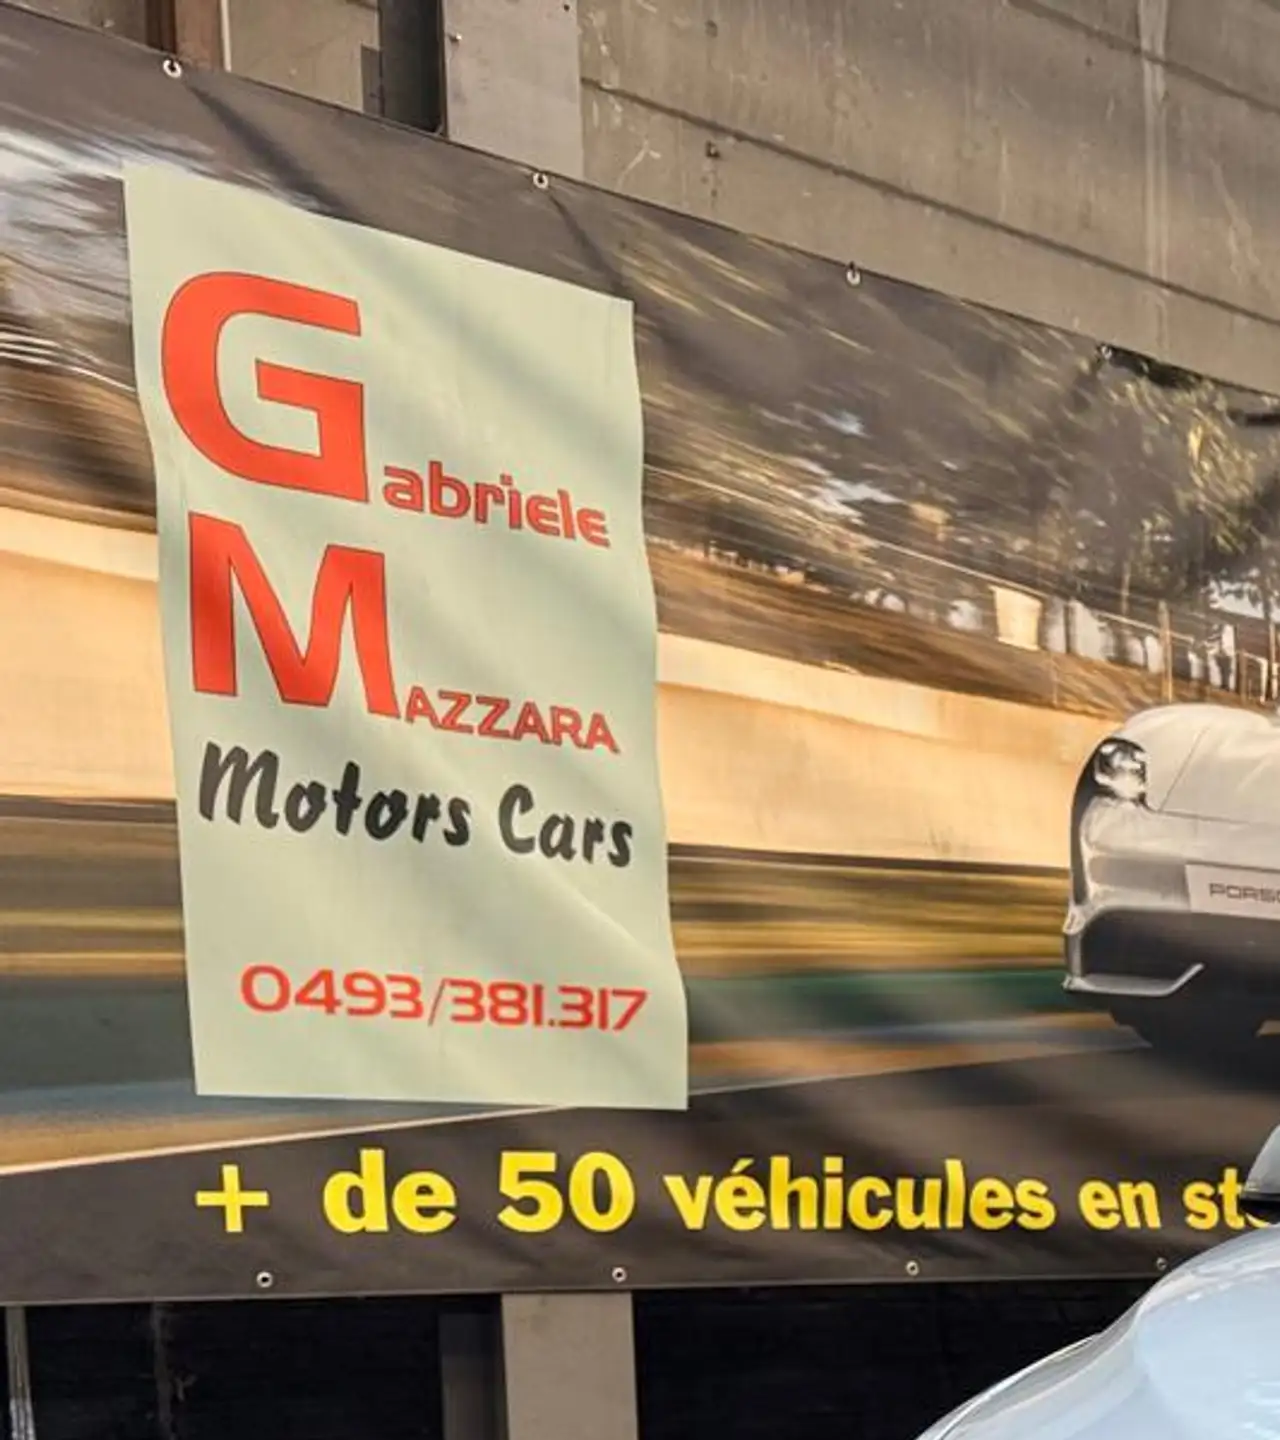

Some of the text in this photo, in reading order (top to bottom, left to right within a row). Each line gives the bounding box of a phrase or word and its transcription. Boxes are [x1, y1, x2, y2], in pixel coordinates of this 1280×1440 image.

[200, 741, 633, 868] Motors Cars
[240, 965, 647, 1032] 0493/381.317
[323, 1149, 456, 1233] de
[498, 1151, 635, 1233] 50
[663, 1155, 1057, 1231] véhicules
[1078, 1178, 1160, 1230] en
[1184, 1167, 1272, 1230] st
